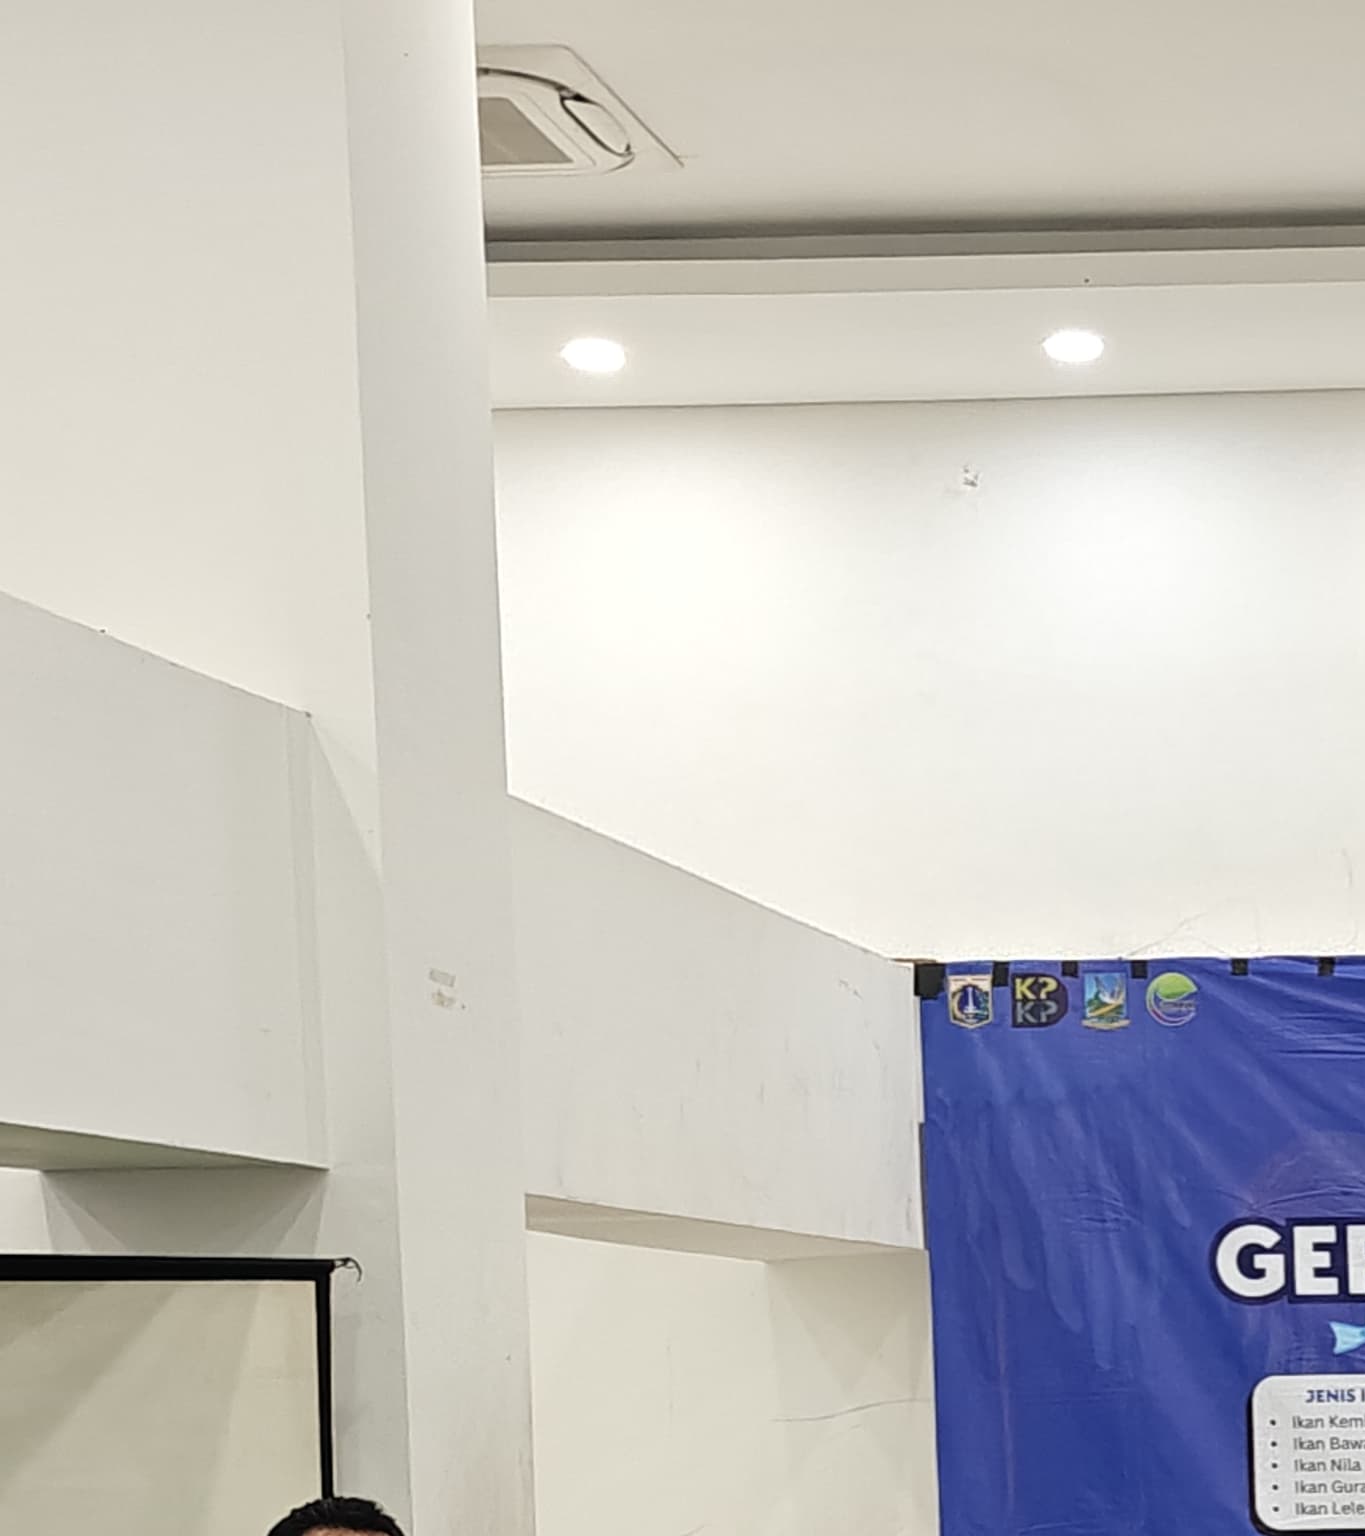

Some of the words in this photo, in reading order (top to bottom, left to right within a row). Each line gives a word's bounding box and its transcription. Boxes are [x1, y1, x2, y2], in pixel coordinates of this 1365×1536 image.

[1305, 1388, 1357, 1403] JENIS
[1292, 1415, 1325, 1429] Ikan
[1293, 1437, 1325, 1450] Ikan
[1294, 1458, 1326, 1472] Ikan
[1330, 1458, 1362, 1472] Nila
[1294, 1481, 1328, 1494] Ikan
[1295, 1502, 1329, 1516] Ikan
